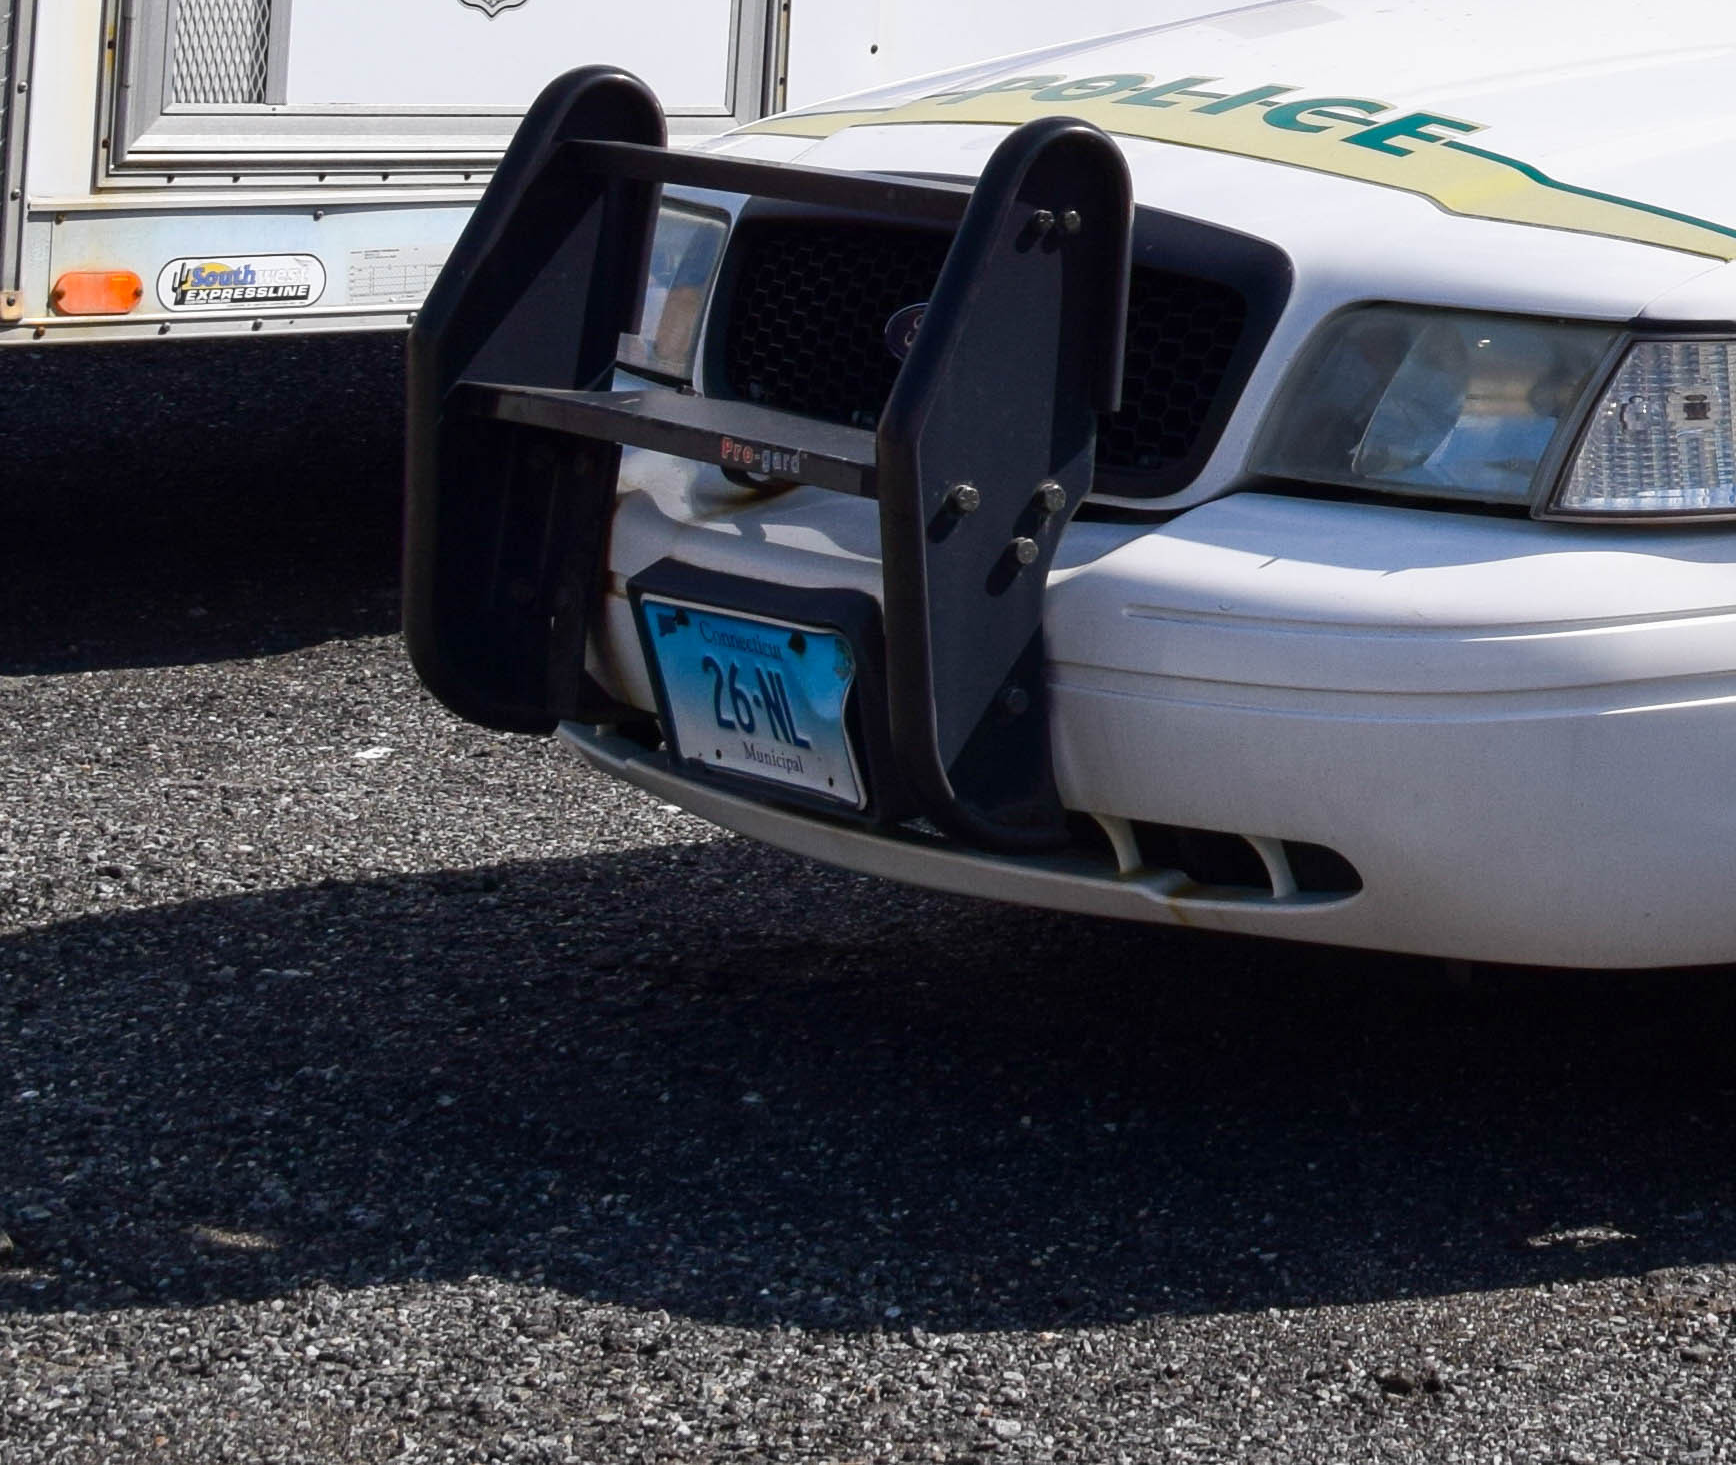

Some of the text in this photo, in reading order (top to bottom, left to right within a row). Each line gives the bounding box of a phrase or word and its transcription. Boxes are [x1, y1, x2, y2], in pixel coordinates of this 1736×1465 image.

[936, 73, 1490, 157] POLICE
[185, 284, 309, 301] EXPRESSLINE
[699, 620, 783, 662] Connecticut
[742, 740, 805, 775] Municipal
